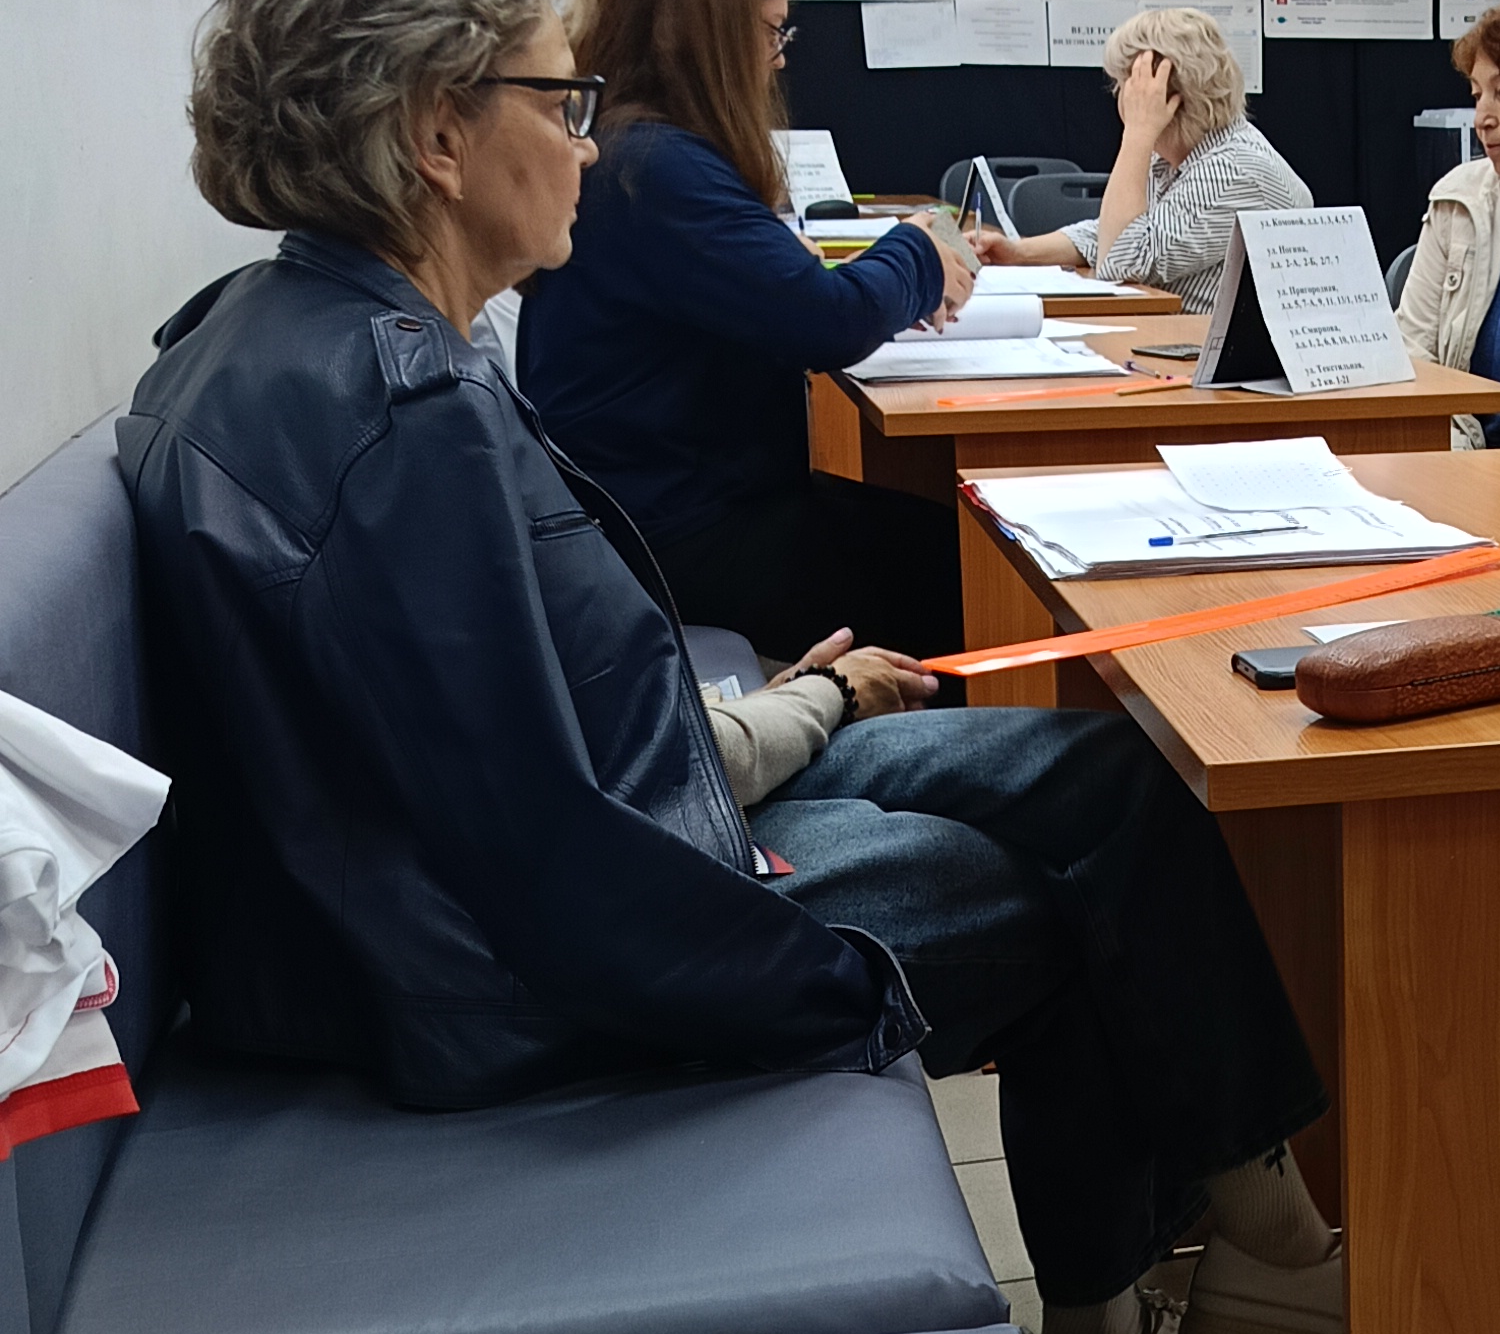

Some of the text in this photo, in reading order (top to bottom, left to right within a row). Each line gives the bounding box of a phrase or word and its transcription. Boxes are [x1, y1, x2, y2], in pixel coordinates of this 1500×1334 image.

[1260, 220, 1271, 230] ул.
[1266, 248, 1278, 257] ул.
[1277, 289, 1289, 299] ул.
[1371, 293, 1379, 302] 17
[1290, 328, 1301, 338] ул.
[1305, 367, 1316, 376] ул.
